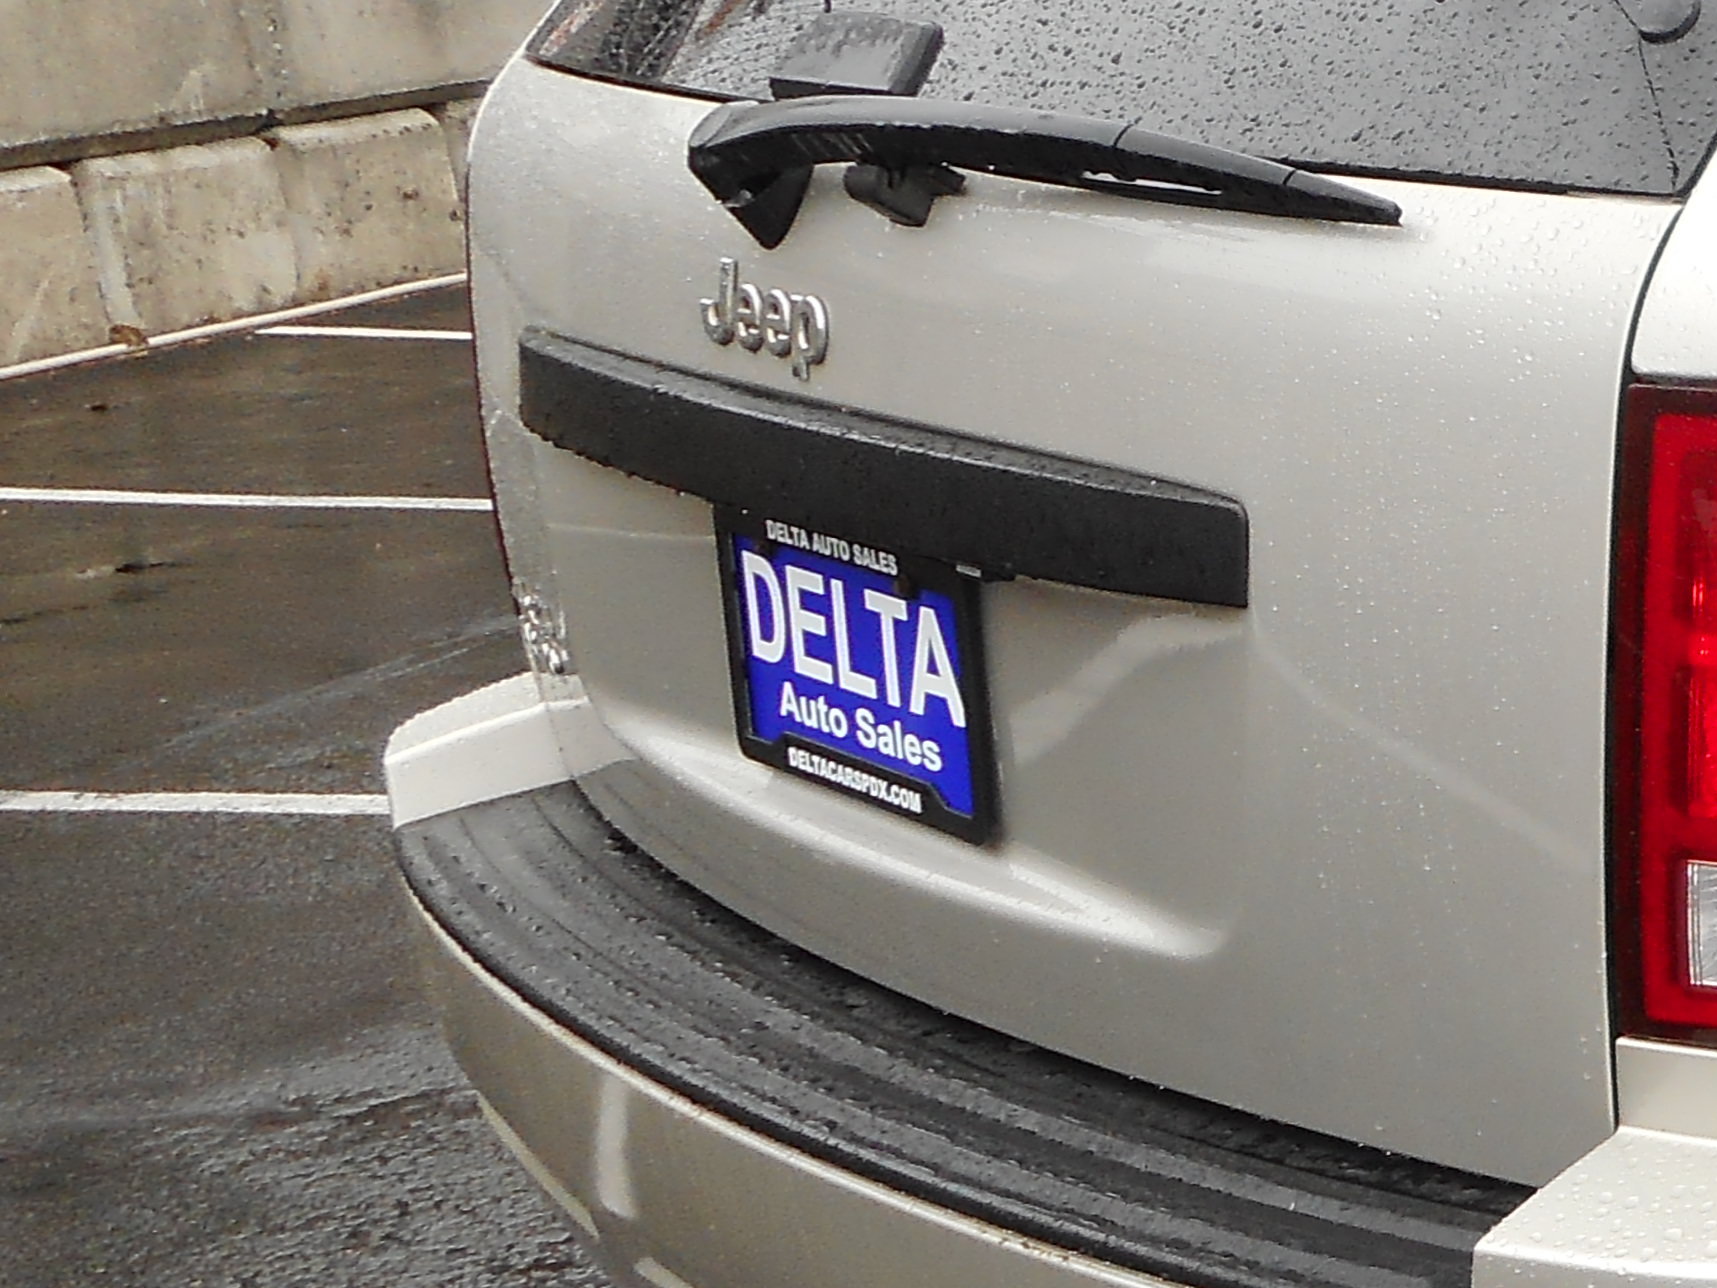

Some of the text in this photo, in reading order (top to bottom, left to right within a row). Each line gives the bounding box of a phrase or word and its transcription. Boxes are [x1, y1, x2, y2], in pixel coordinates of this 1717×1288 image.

[699, 256, 830, 382] Jeep
[765, 518, 898, 577] DELTA AUTO SALES
[741, 549, 967, 728] DELTA
[779, 680, 943, 772] Auto Sales
[787, 746, 923, 814] DELTACARSPDX.COM
